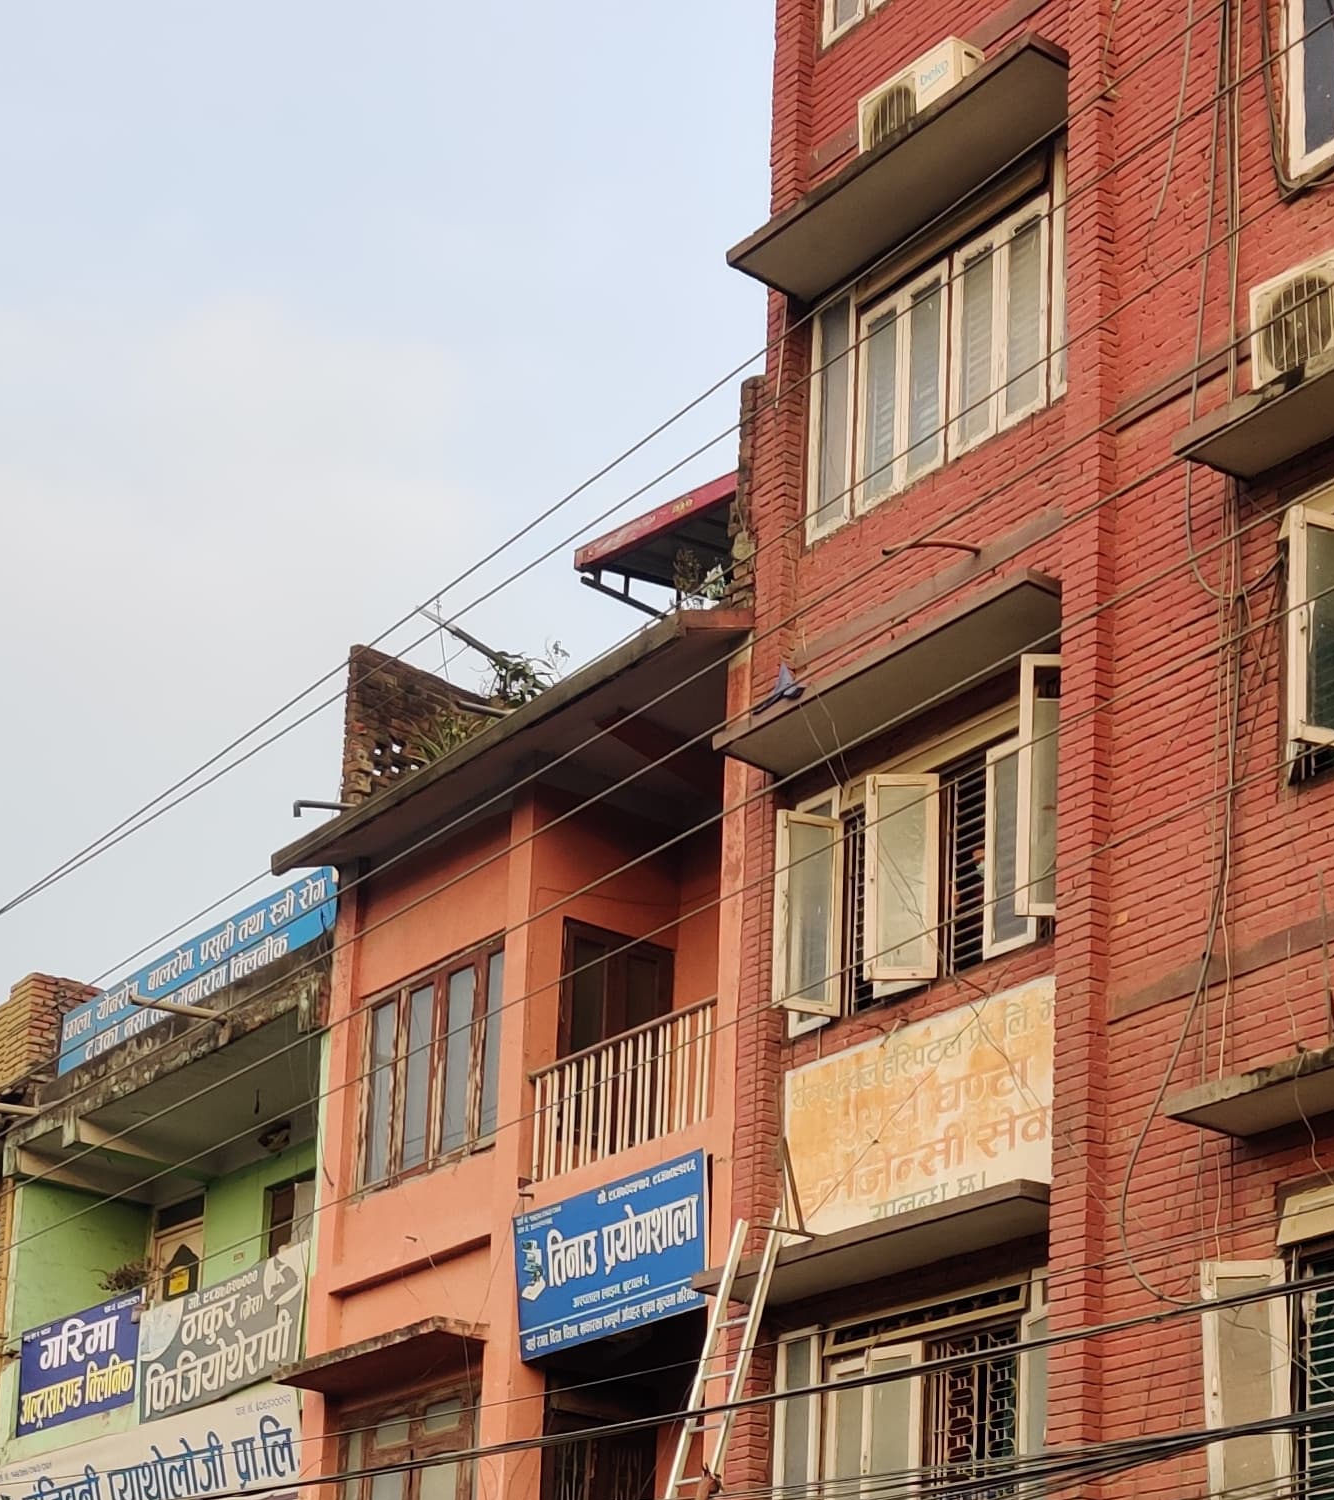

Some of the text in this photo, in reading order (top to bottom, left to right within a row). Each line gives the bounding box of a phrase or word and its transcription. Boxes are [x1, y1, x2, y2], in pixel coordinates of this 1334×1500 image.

[239, 910, 267, 942] तथा
[299, 877, 327, 910] रोग
[546, 1228, 598, 1288] तिनाउ
[601, 1194, 699, 1276] प्रयोगशाला
[39, 1315, 120, 1370] गरिमा
[181, 1293, 240, 1346] ठाकुर
